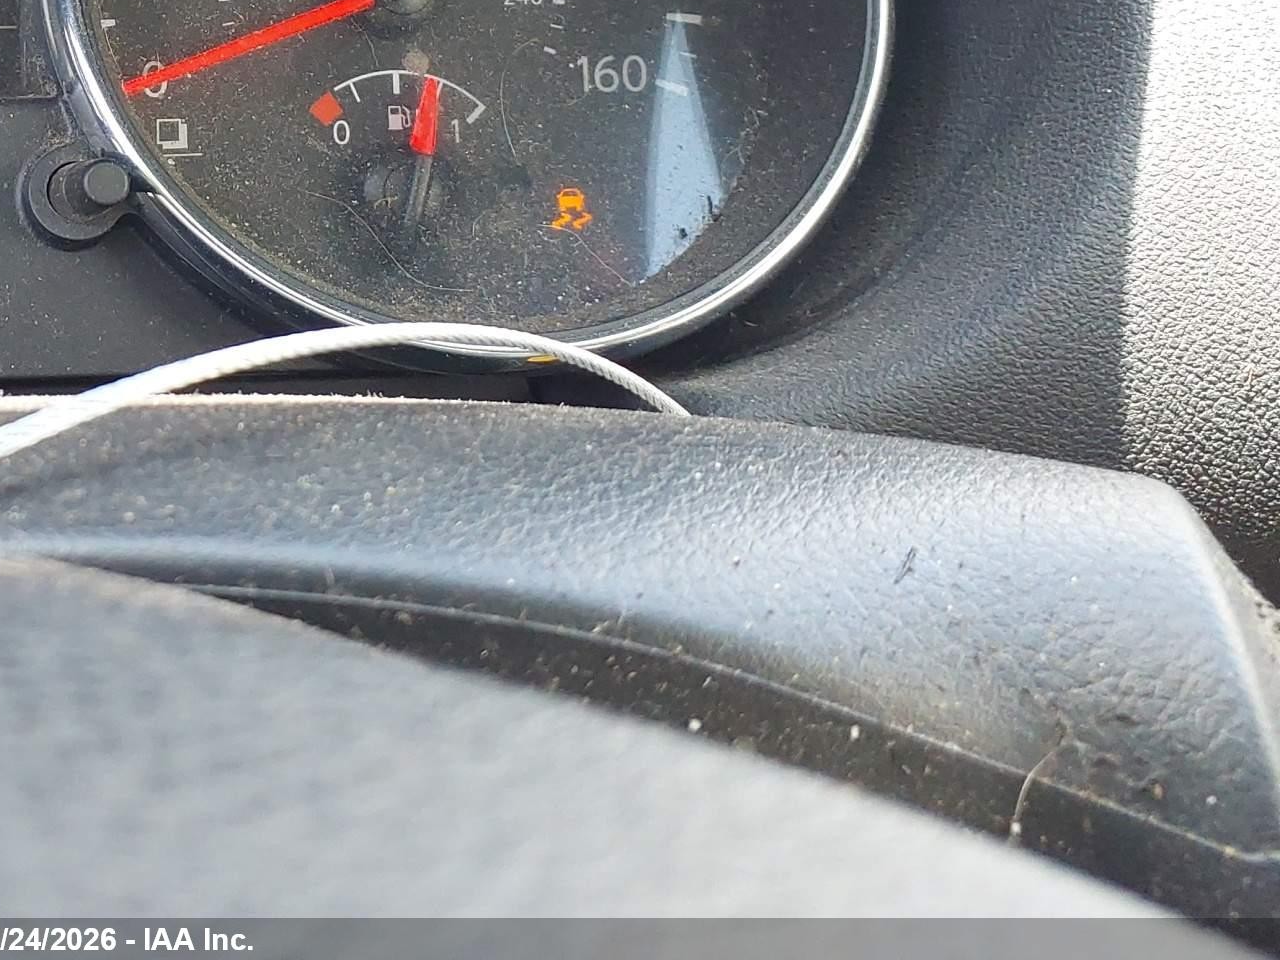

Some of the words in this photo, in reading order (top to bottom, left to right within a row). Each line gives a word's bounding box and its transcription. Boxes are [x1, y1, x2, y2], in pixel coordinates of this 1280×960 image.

[576, 55, 647, 93] 160
[333, 120, 350, 145] 0
[451, 119, 461, 143] 1
